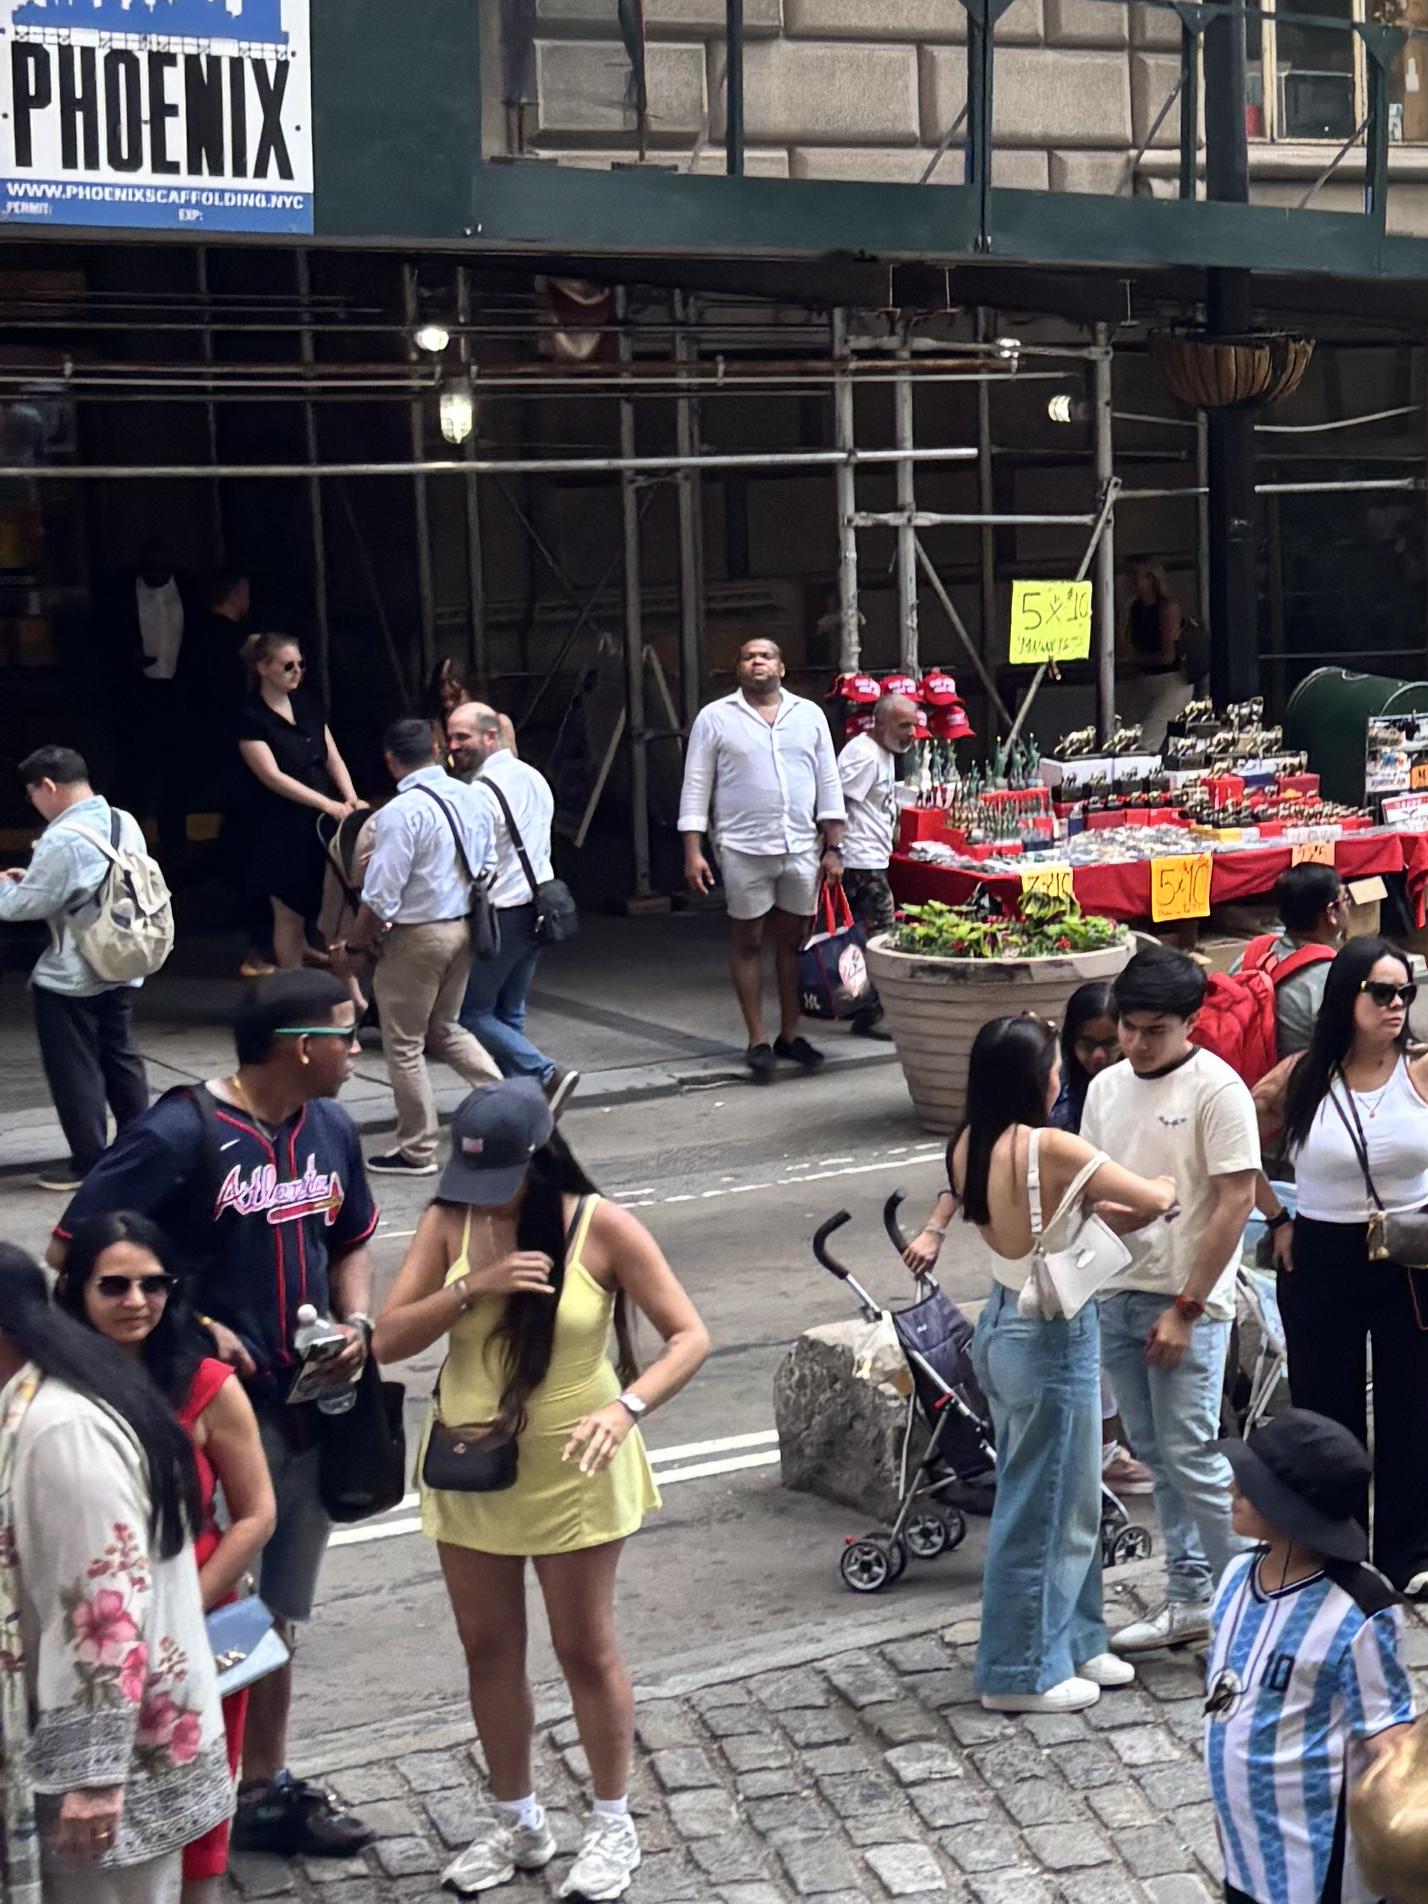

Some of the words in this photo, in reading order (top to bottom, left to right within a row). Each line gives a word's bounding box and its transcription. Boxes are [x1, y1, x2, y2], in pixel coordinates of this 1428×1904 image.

[11, 40, 295, 180] PHOENIX
[6, 182, 304, 209] WWW.PHOENIXSCAFFOLDING.NYC
[213, 1153, 330, 1221] Atlanta
[1260, 1649, 1295, 1693] 10
